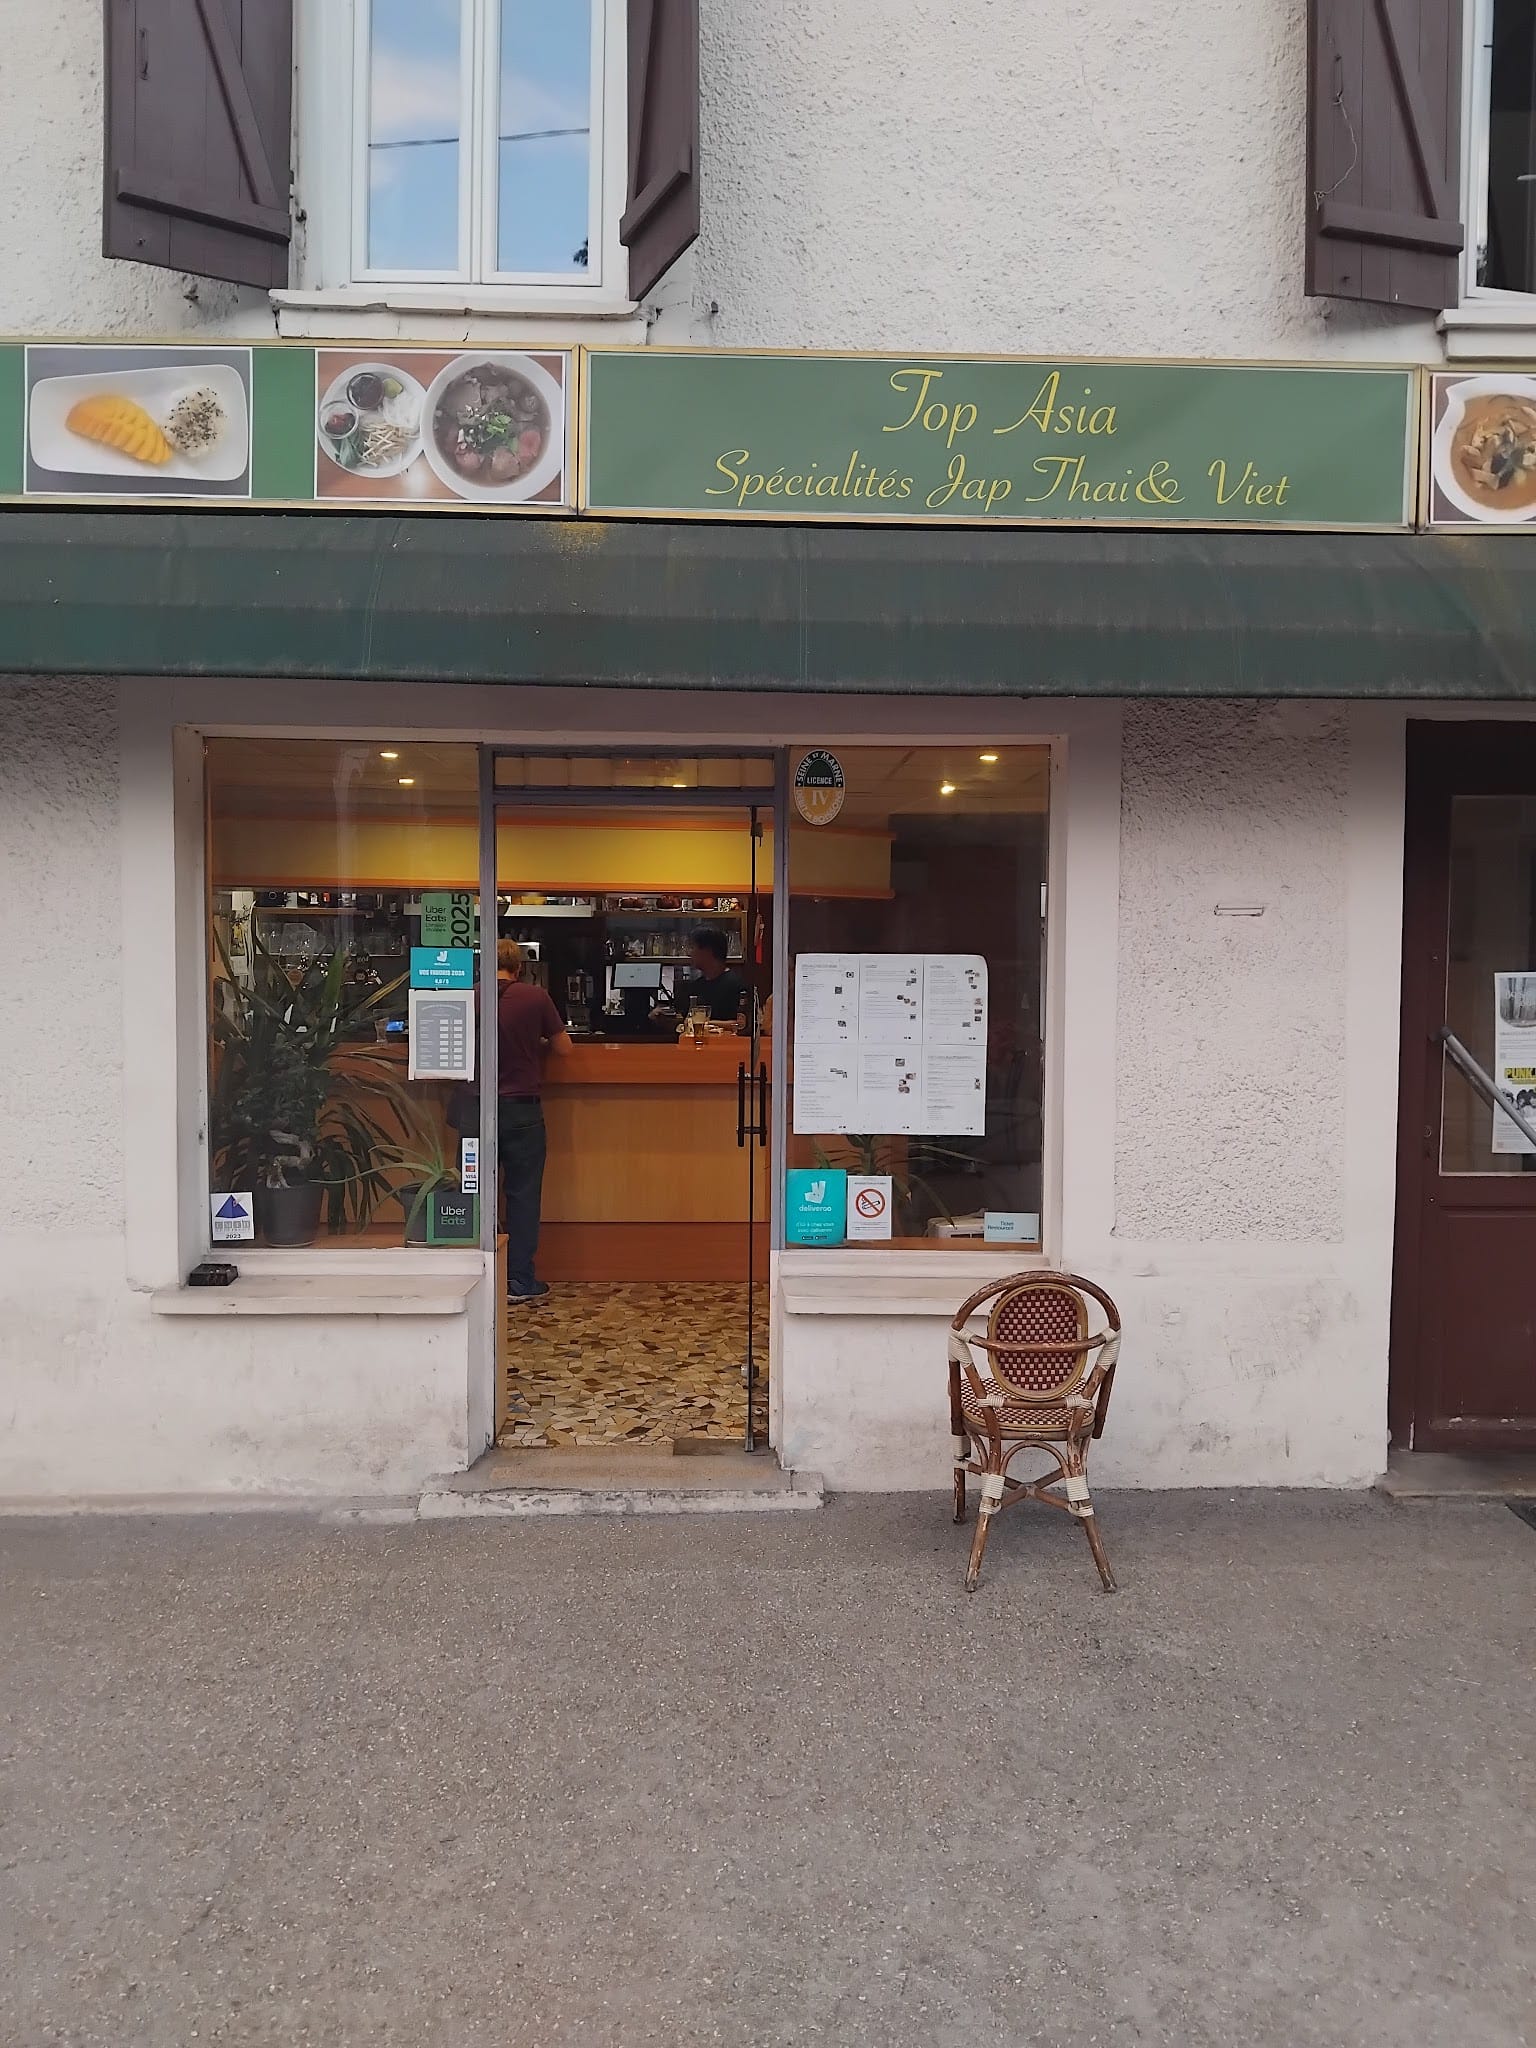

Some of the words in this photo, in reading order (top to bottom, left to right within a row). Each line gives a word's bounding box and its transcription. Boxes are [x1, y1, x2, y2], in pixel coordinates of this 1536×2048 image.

[882, 368, 978, 449] Top
[992, 370, 1118, 434] Asia
[704, 449, 914, 507] Spécialités
[925, 453, 1013, 513] Jap
[1207, 458, 1292, 506] Viet
[796, 757, 813, 782] SEINE
[820, 751, 843, 783] MARNE
[806, 776, 833, 784] LICENCE
[812, 790, 828, 806] IV
[425, 905, 447, 914] Uber
[425, 914, 447, 922] Eats
[450, 893, 470, 947] 2025
[440, 1205, 467, 1216] Uber
[798, 1204, 832, 1212] deliveroo
[440, 1216, 466, 1225] Eats
